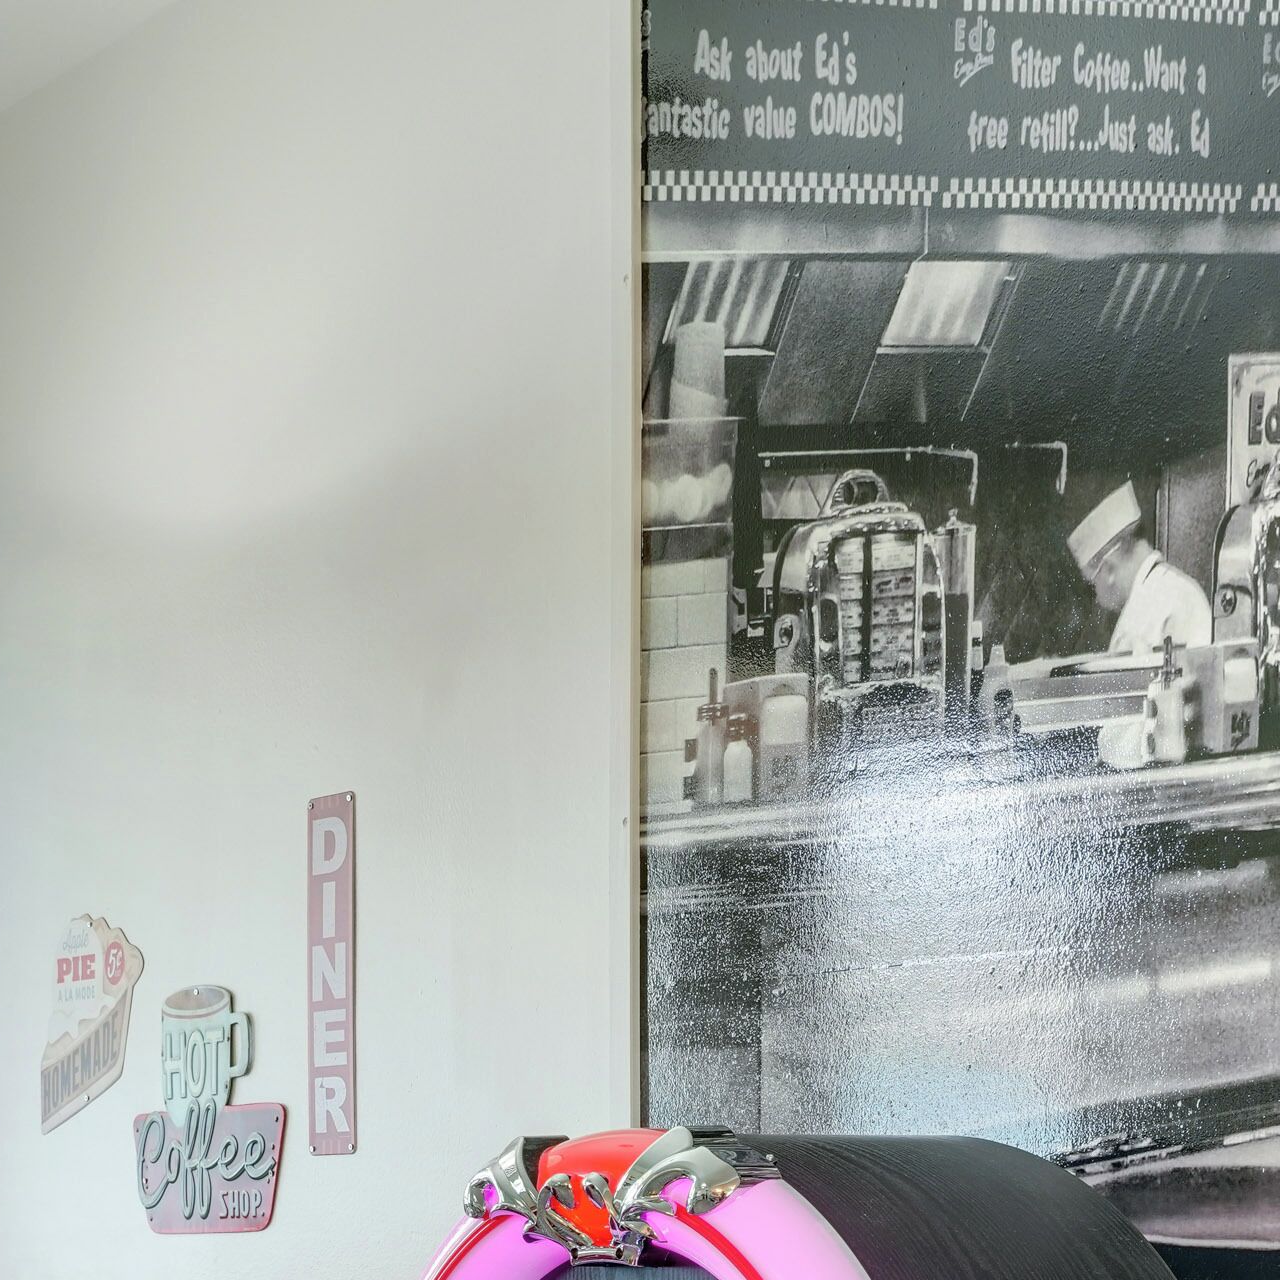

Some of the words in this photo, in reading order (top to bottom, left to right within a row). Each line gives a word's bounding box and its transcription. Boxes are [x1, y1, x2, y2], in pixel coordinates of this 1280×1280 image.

[694, 28, 732, 82] Ask
[745, 39, 803, 83] about
[815, 31, 857, 86] Ed's
[954, 15, 996, 53] Ed's
[1011, 38, 1061, 89] Filter
[1197, 64, 1207, 95] a
[744, 95, 796, 140] value
[810, 91, 904, 145] COMBOS!
[968, 110, 1008, 152] free
[1147, 115, 1180, 155] ask.
[1190, 108, 1209, 158] Ed
[56, 953, 96, 984] PIE
[311, 816, 350, 1134] DINER
[42, 1009, 120, 1117] HOMEMADE
[162, 1026, 226, 1100] HOT
[137, 1097, 276, 1220] Coffee
